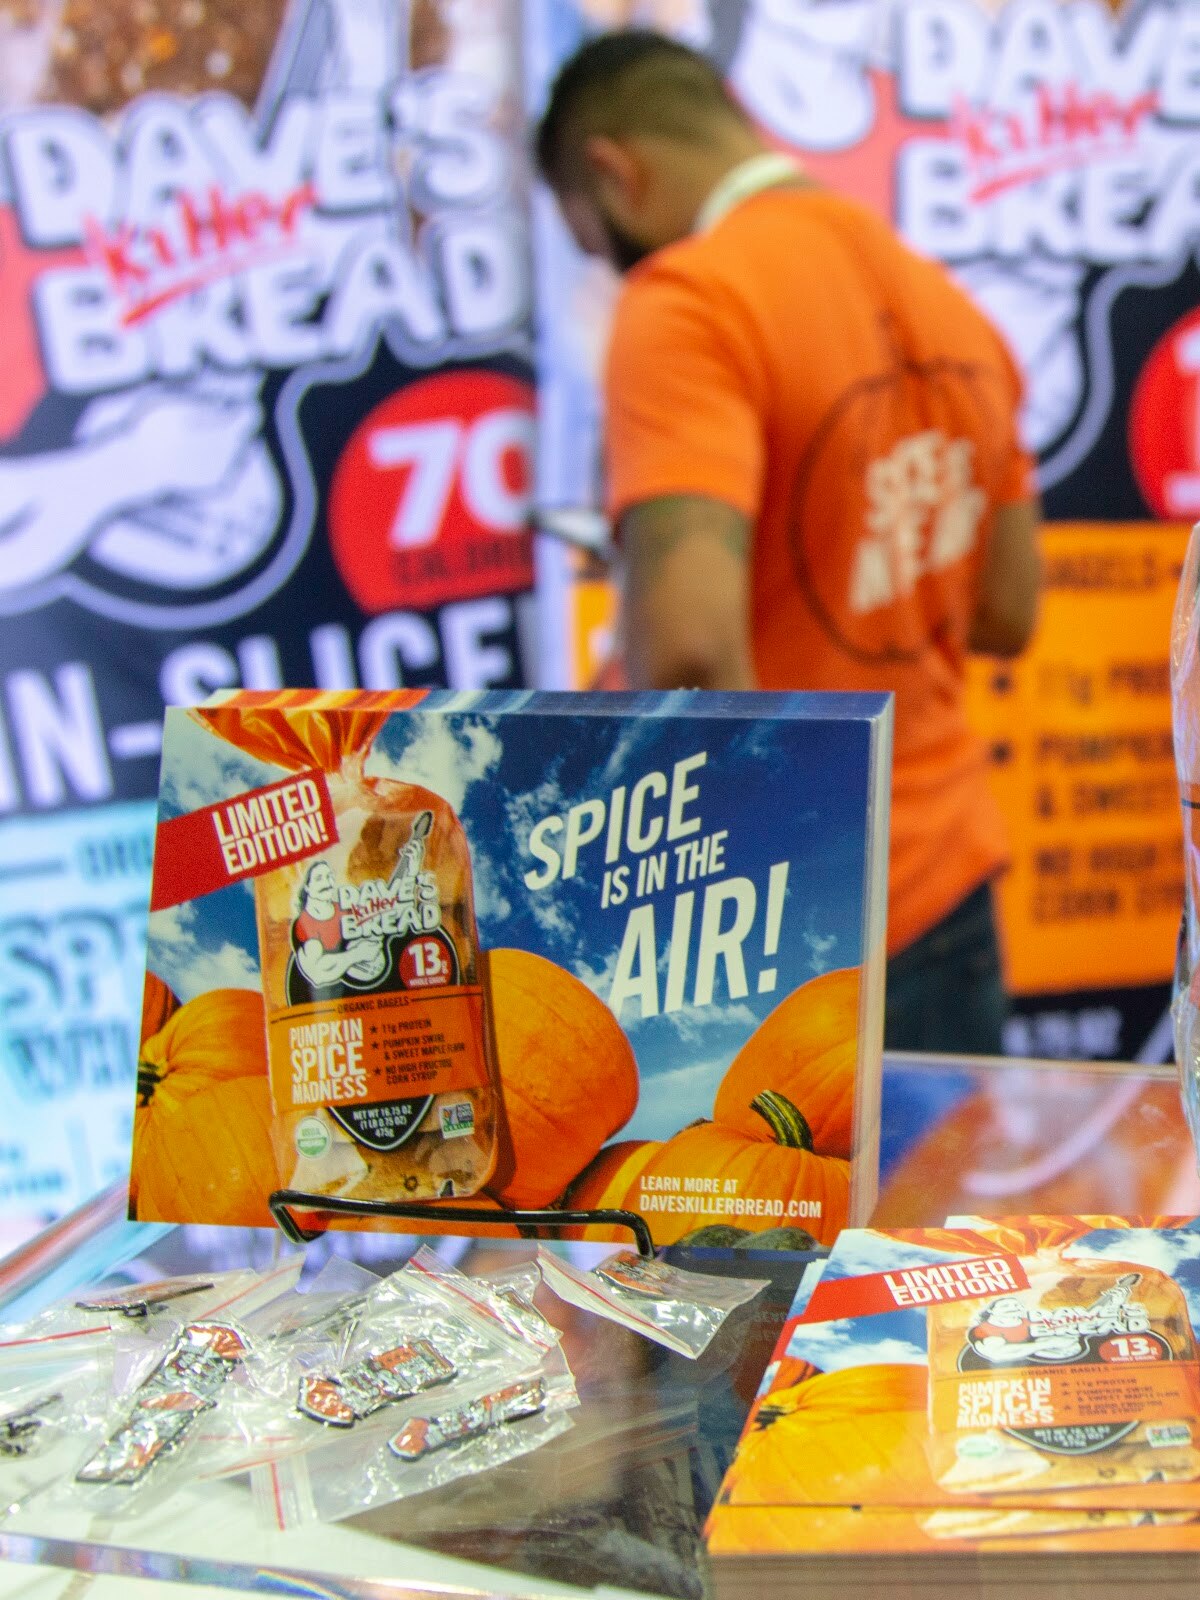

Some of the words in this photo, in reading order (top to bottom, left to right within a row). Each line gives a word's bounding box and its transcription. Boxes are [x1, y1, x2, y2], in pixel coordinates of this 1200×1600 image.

[10, 78, 502, 242] DAVE'S
[36, 225, 524, 391] BREAD
[212, 779, 322, 845] LIMITED
[523, 751, 708, 891] SPICE
[221, 811, 329, 875] EDITION!
[601, 865, 630, 909] IS
[636, 851, 667, 897] IN
[674, 829, 729, 885] THE
[338, 873, 438, 910] DAVE'S
[341, 903, 441, 939] BREAD
[607, 861, 790, 1020] AIR!
[337, 1000, 375, 1014] ORGANIC
[377, 996, 410, 1010] BAGELS
[289, 1018, 364, 1050] PUMPKIN
[290, 1041, 367, 1085] SPICE
[292, 1074, 368, 1106] MADNESS
[353, 1109, 369, 1121] NET
[640, 1175, 681, 1192] LEARN
[684, 1177, 720, 1194] MORE
[723, 1179, 739, 1194] AT
[639, 1194, 822, 1219] DAVESKILLERBREAD.COM
[883, 1257, 1012, 1293] LIMITED
[891, 1272, 1018, 1307] EDITION!
[958, 1377, 1051, 1396] PUMPKIN
[958, 1392, 1051, 1416] SPICE
[956, 1409, 1055, 1428] MADNESS
